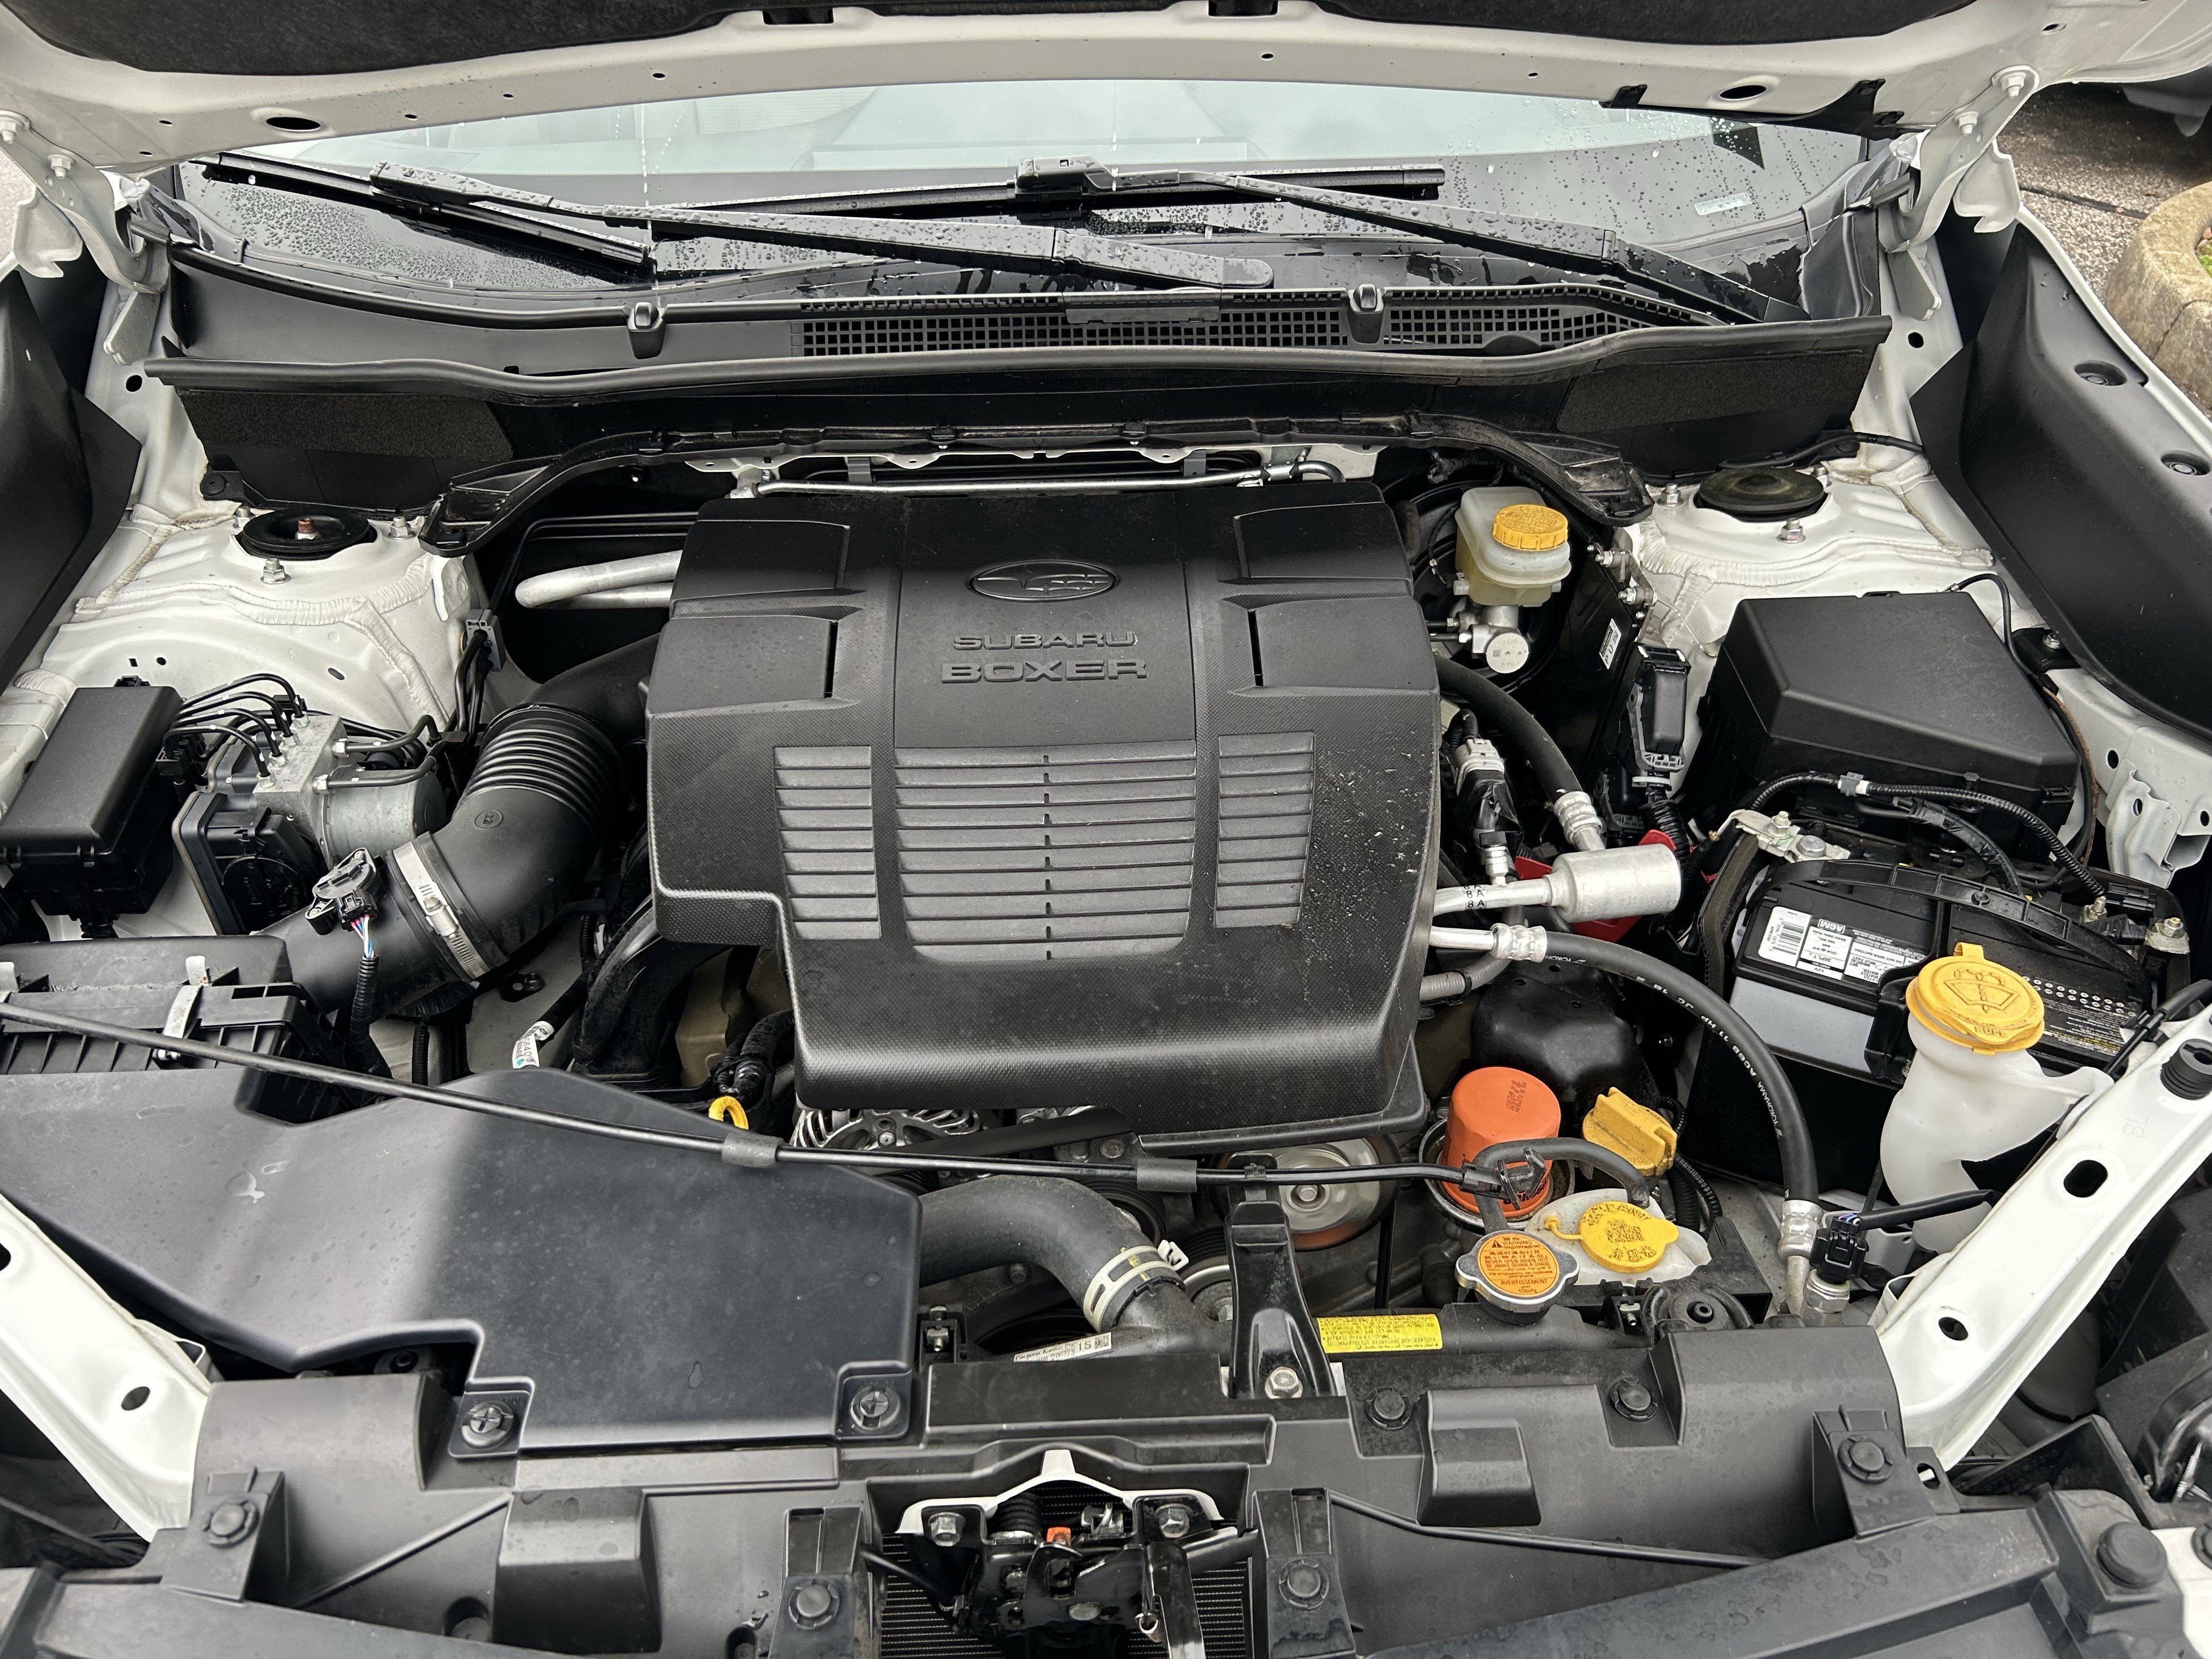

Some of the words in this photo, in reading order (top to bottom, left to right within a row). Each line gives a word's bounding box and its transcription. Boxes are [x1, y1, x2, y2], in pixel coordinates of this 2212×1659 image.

[953, 631, 1138, 651] SUBARU
[941, 658, 1148, 684] BOXER
[1757, 1081, 1778, 1125] YOKOHAMA
